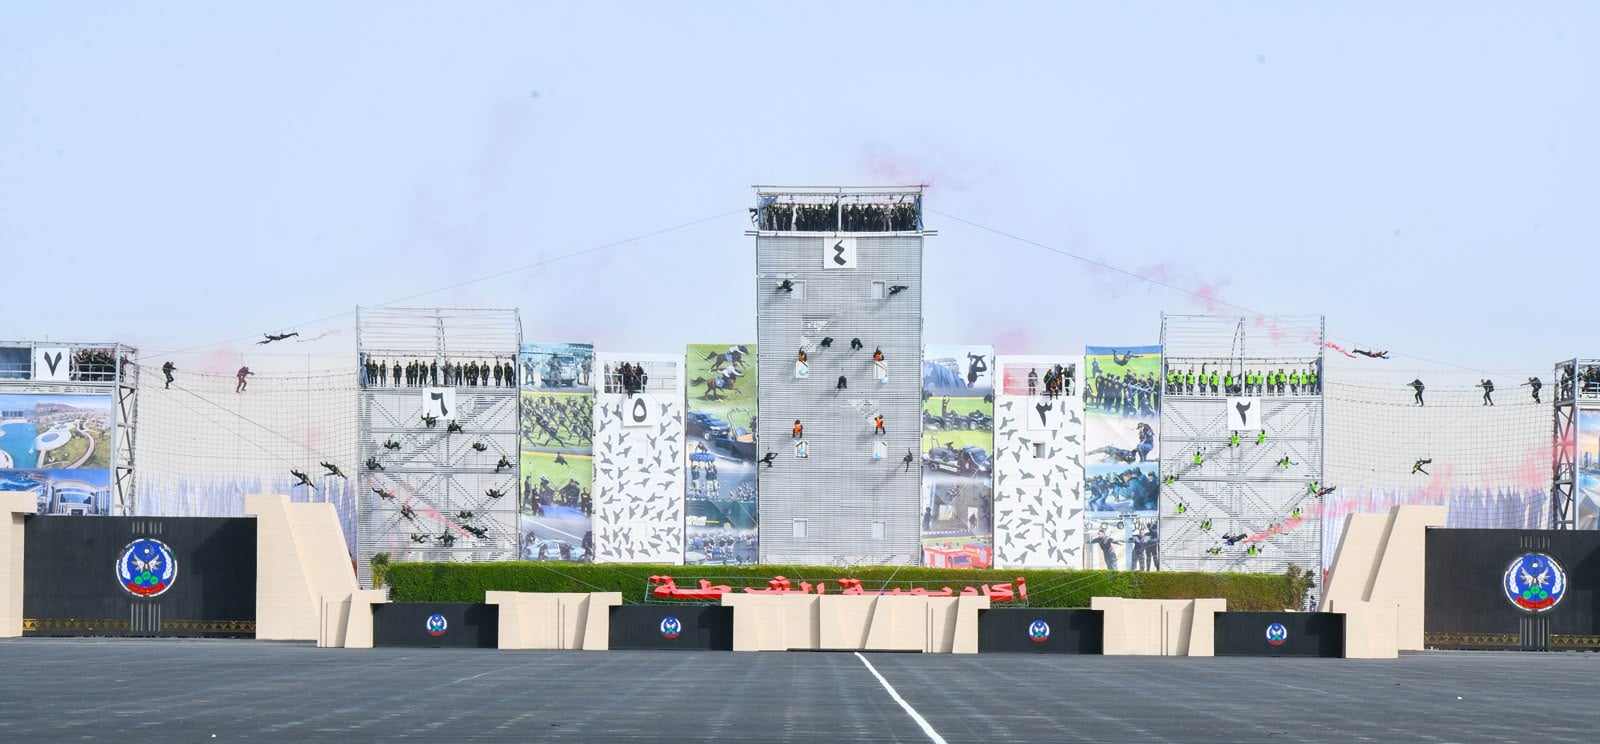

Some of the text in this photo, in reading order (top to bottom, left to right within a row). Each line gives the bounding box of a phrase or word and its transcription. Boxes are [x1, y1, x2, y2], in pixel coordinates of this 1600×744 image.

[833, 239, 847, 266] ٤
[44, 351, 62, 377] ٧
[430, 391, 448, 417] ٦
[632, 397, 647, 423] ٥
[1035, 401, 1053, 428] ٣
[1235, 400, 1251, 427] ٢
